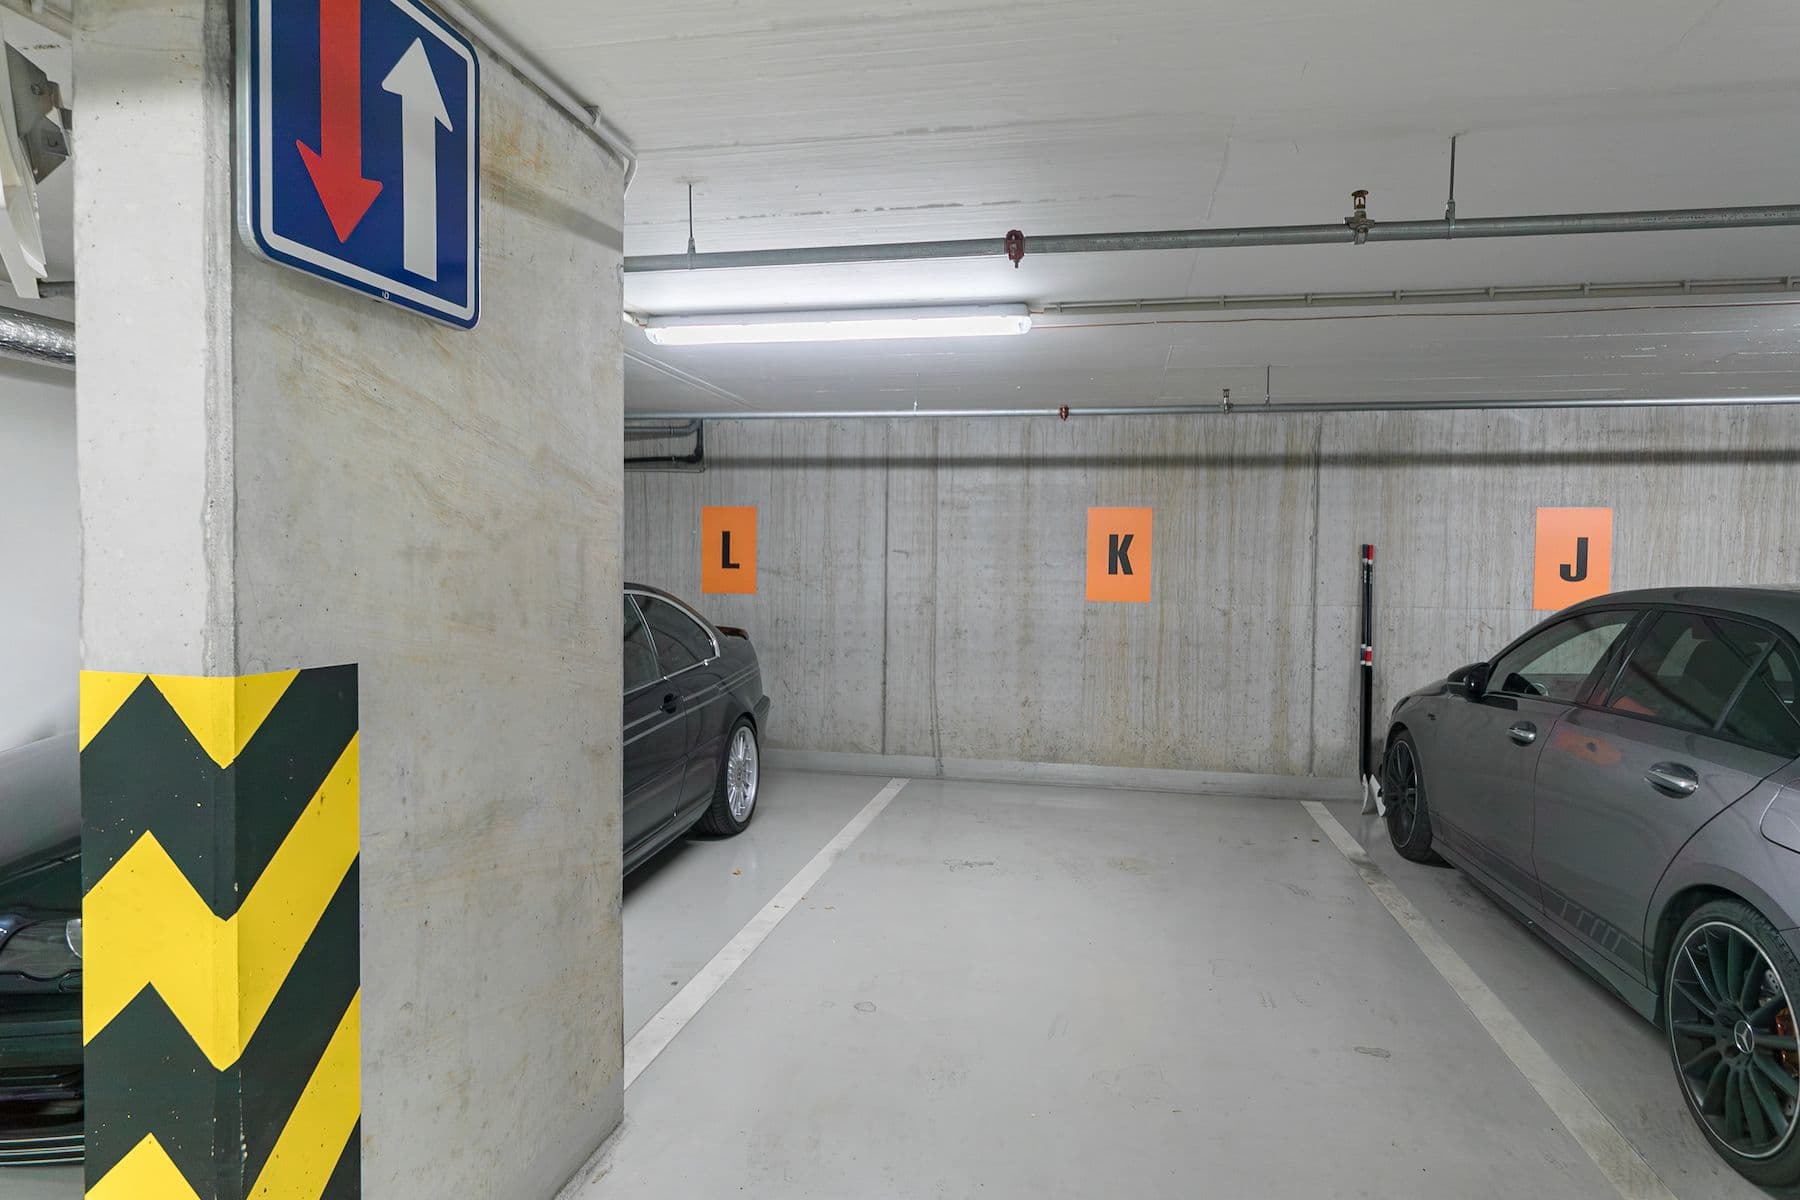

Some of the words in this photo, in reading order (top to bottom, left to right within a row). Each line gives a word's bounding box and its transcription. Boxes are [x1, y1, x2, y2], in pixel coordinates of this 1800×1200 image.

[721, 530, 740, 569] L
[1108, 534, 1134, 576] K
[1559, 537, 1589, 582] J
